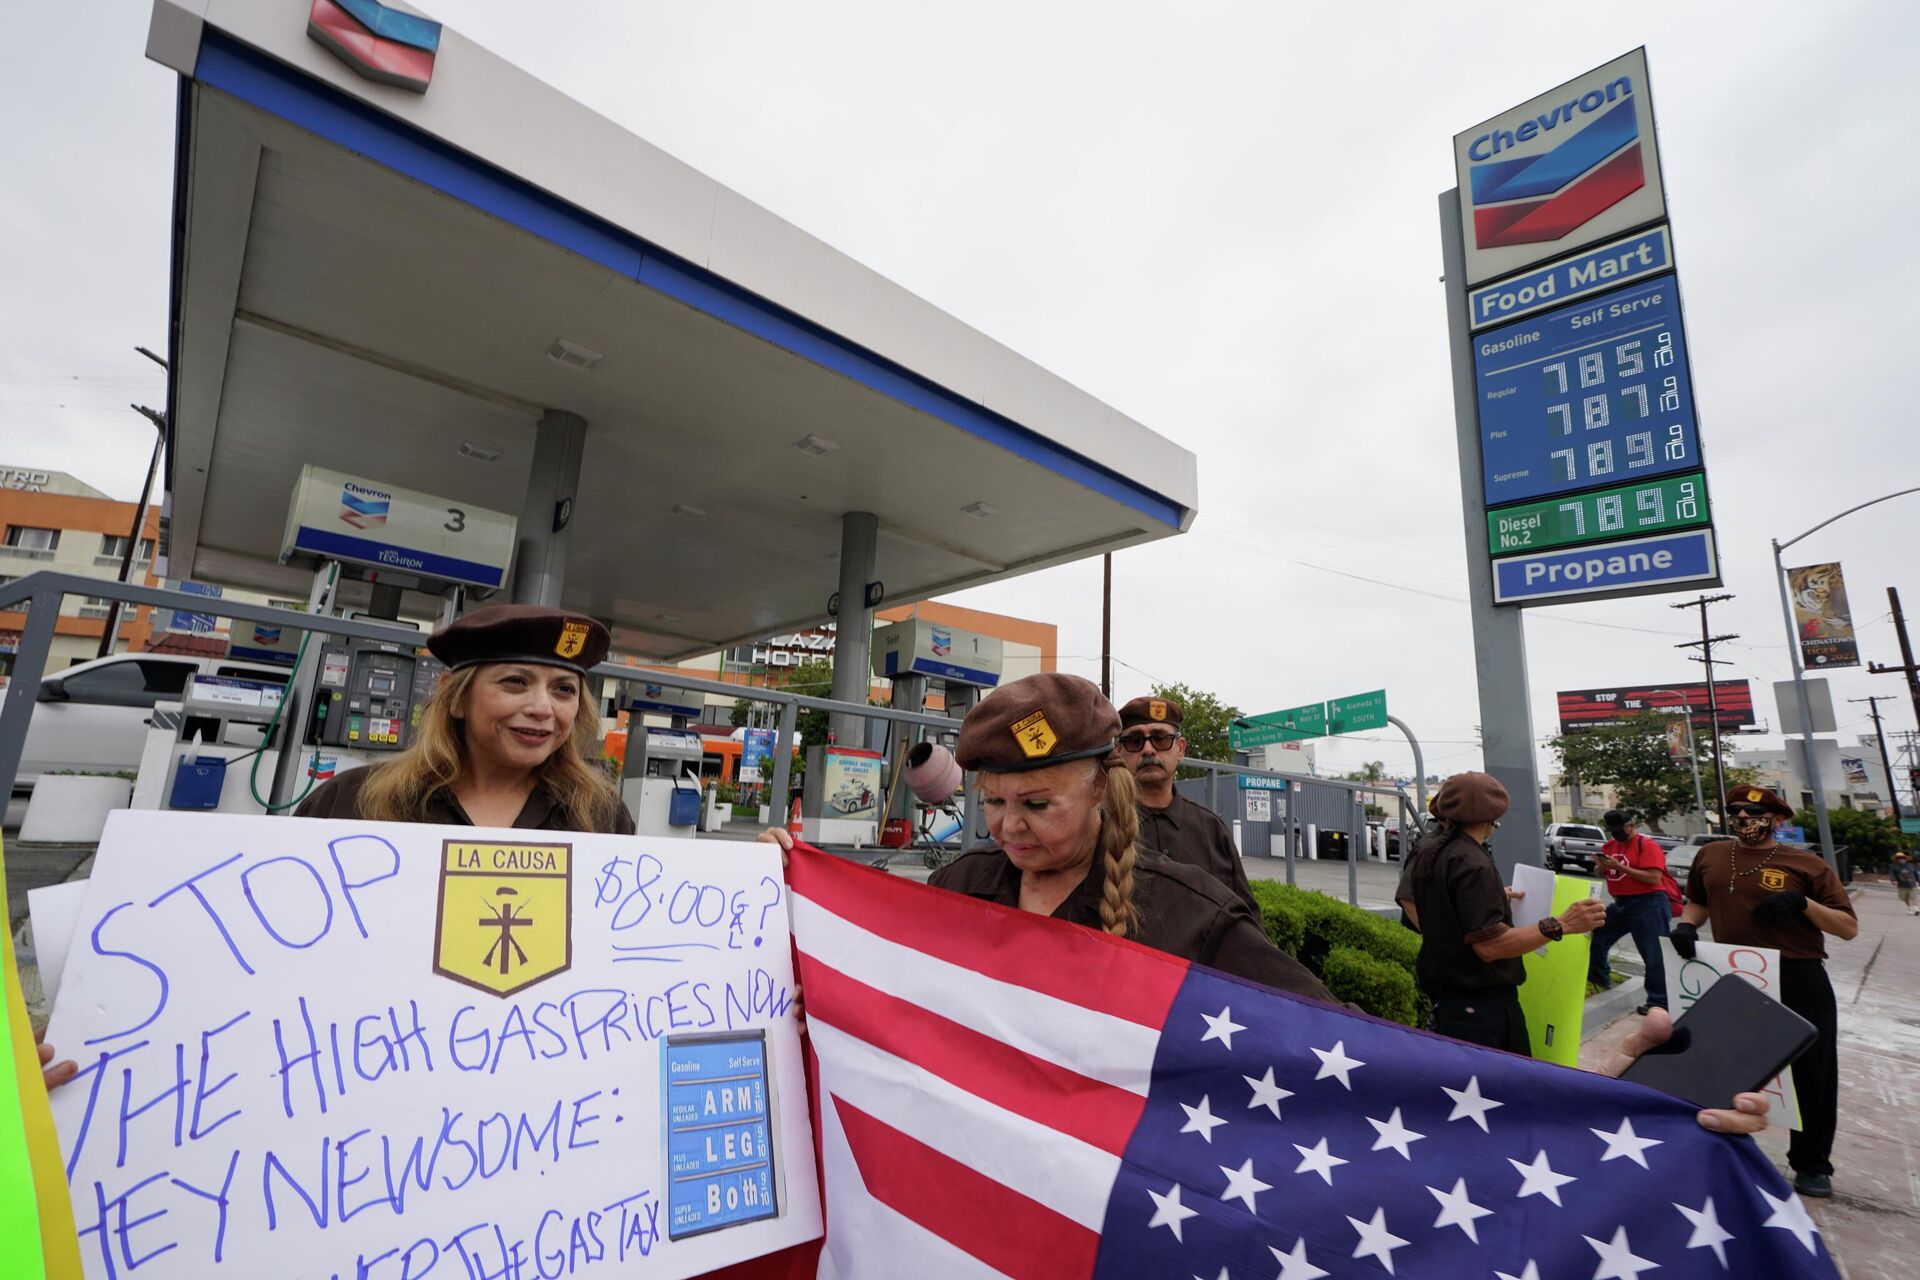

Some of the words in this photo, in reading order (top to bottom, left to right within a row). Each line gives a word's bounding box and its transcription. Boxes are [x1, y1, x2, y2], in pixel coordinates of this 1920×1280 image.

[1467, 75, 1633, 162] Chevron
[1481, 273, 1555, 317] Food
[1569, 242, 1654, 289] Mart
[1570, 309, 1603, 330] Self
[1610, 293, 1663, 317] Serve
[1481, 330, 1541, 357] Gasoline
[1543, 340, 1645, 394] 785
[1487, 385, 1517, 400] Regular
[1547, 383, 1650, 435] 787
[1490, 429, 1507, 440] Plus
[1551, 430, 1655, 481] 789
[1494, 468, 1530, 483] Supreme
[344, 482, 391, 500] Chevron
[443, 508, 466, 533] 3
[1559, 487, 1666, 536] 789
[1498, 513, 1542, 535] Diesel
[1500, 531, 1532, 549] No.2
[378, 551, 424, 569] TECHRON
[1524, 549, 1674, 586] Propane
[886, 634, 899, 646] Self
[973, 638, 978, 653] 1
[1801, 636, 1855, 646] CHINATOWN
[1346, 700, 1373, 710] Alameda
[1374, 697, 1382, 705] St
[1595, 693, 1617, 702] STOP
[1624, 700, 1642, 709] THE
[1352, 714, 1375, 724] SOUTH
[1245, 777, 1281, 788] PROPANE
[457, 850, 481, 870] LA
[492, 849, 557, 871] CAUSA
[595, 854, 725, 931] $8.00
[84, 834, 400, 1046] STOP
[671, 1061, 701, 1073] Gasoline
[728, 1057, 742, 1069] Self
[742, 1056, 761, 1067] Serve
[66, 1010, 251, 1187] THE
[273, 997, 433, 1118] HIGH
[726, 968, 793, 1030] NOW
[672, 1104, 695, 1114] REGULAR
[703, 1085, 752, 1116] ARM
[672, 1111, 699, 1122] UNLEADED
[705, 1130, 753, 1164] LEG
[673, 1155, 687, 1164] PLUS
[673, 1161, 700, 1172] UNLEADED
[707, 1177, 758, 1215] Both
[674, 1204, 692, 1215] SUPER
[674, 1211, 702, 1226] UNLEADED
[534, 1209, 605, 1280] GAS
[603, 1190, 660, 1264] TAX
